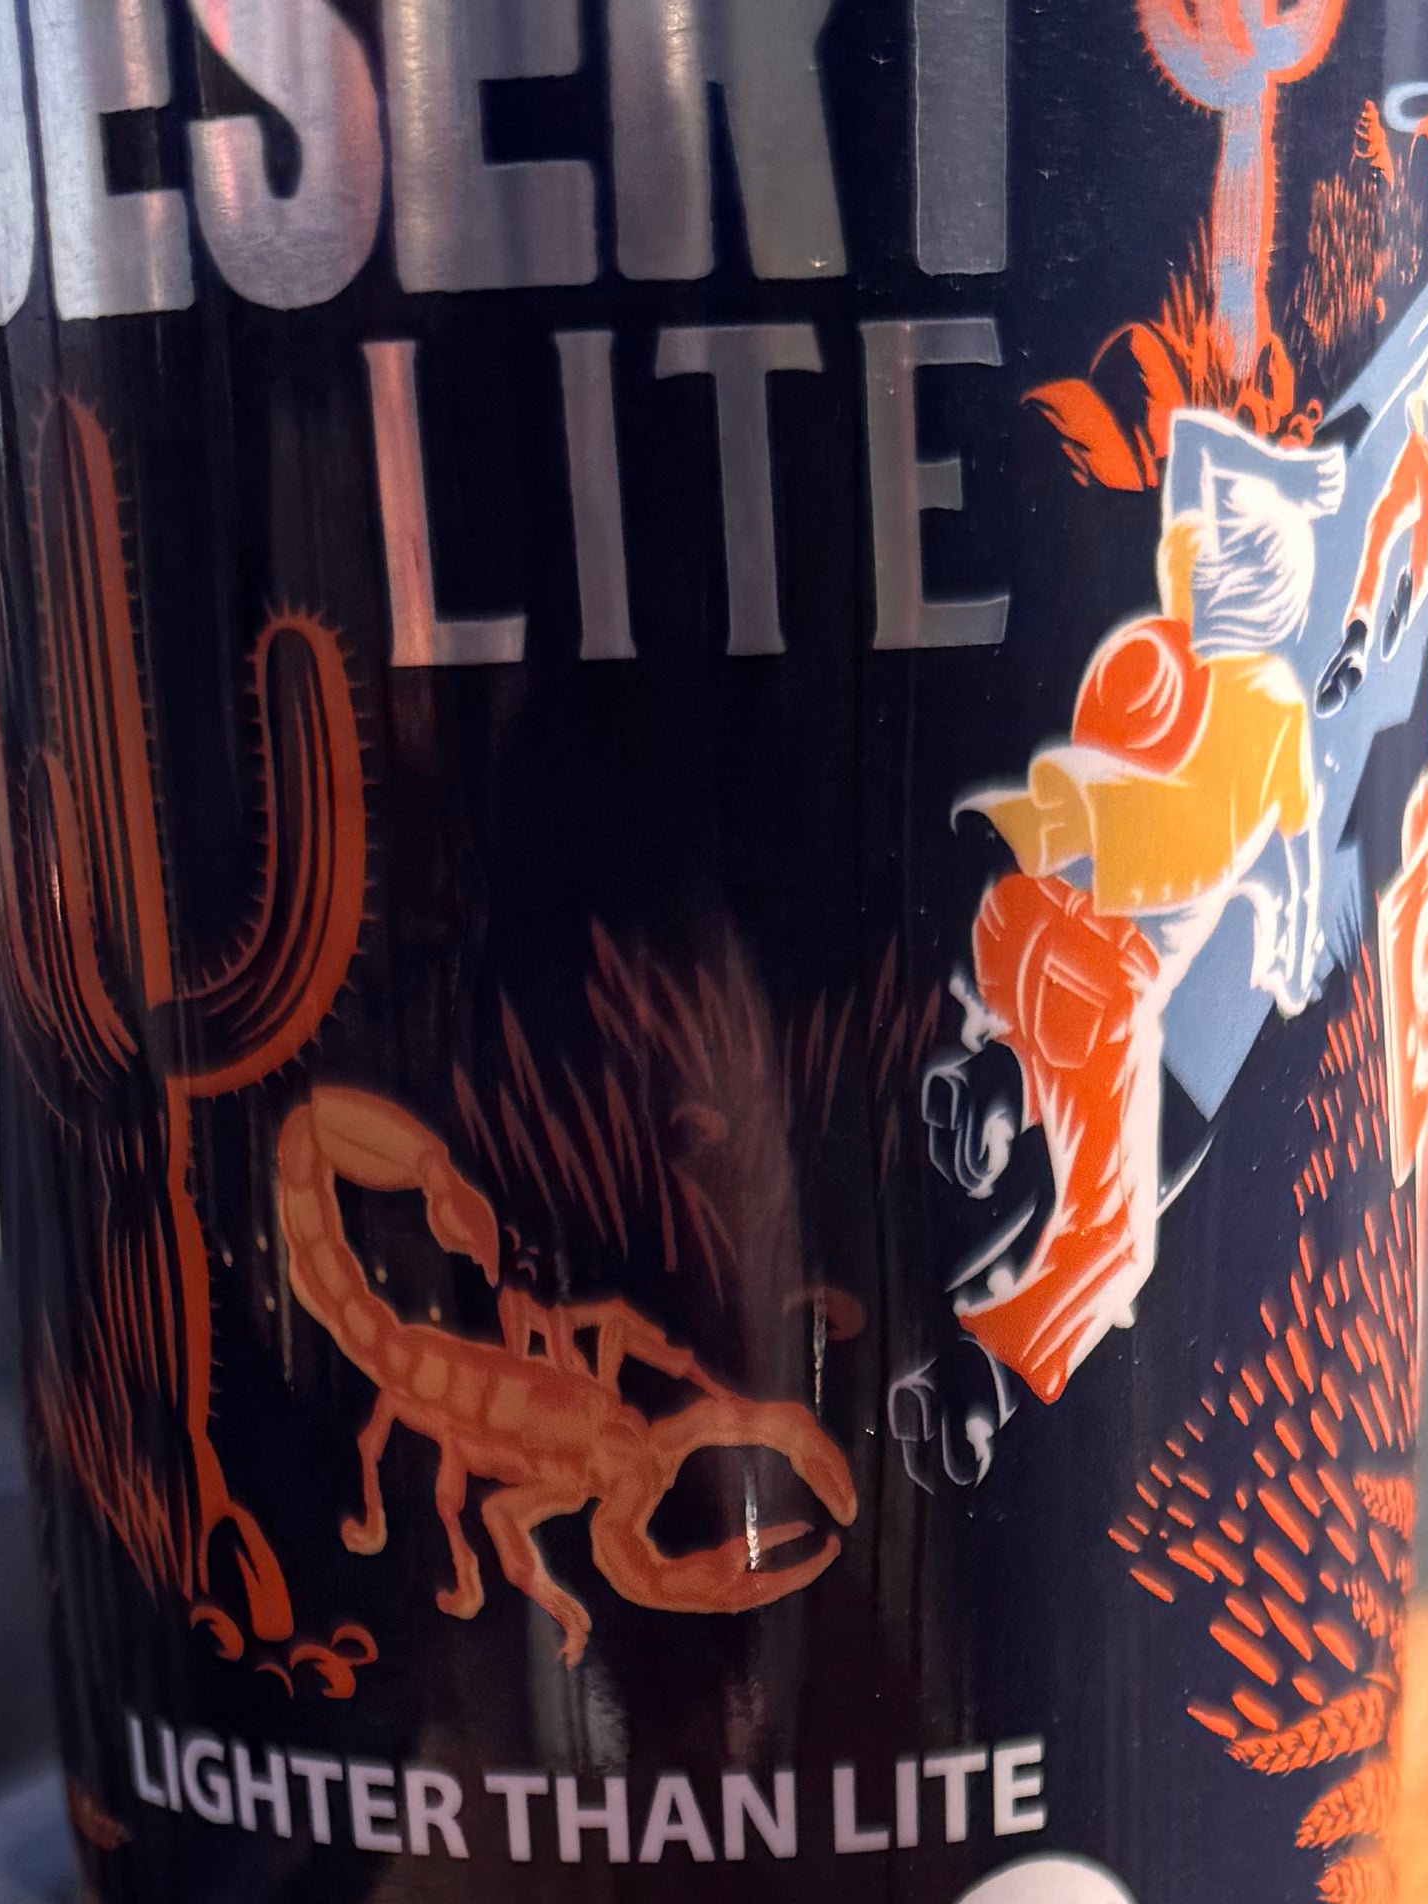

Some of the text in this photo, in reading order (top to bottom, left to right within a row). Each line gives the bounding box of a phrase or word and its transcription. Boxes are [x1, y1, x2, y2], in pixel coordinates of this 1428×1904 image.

[362, 316, 1009, 667] LITE
[125, 1714, 1047, 1864] LIGHTER THAN LITE
